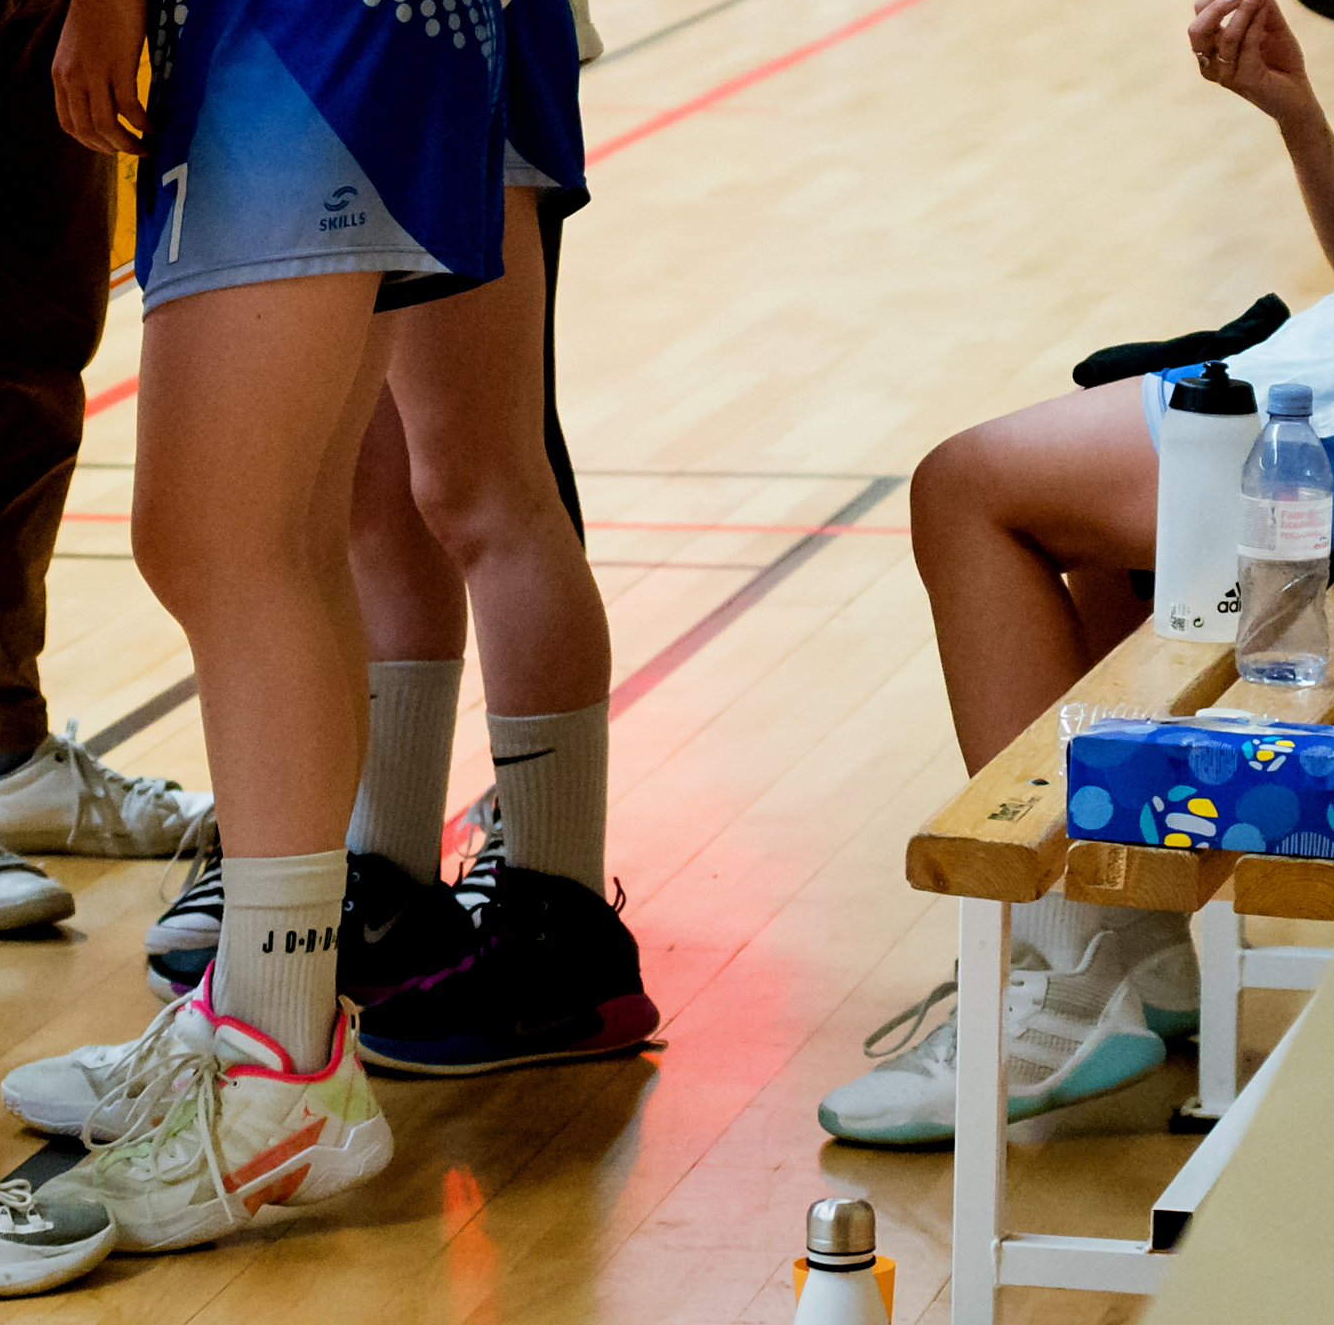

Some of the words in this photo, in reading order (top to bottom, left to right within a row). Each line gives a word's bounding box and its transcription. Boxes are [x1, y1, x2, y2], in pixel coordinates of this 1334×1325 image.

[319, 212, 366, 232] SKILLS
[1217, 596, 1242, 614] adi
[262, 926, 339, 954] JORD
